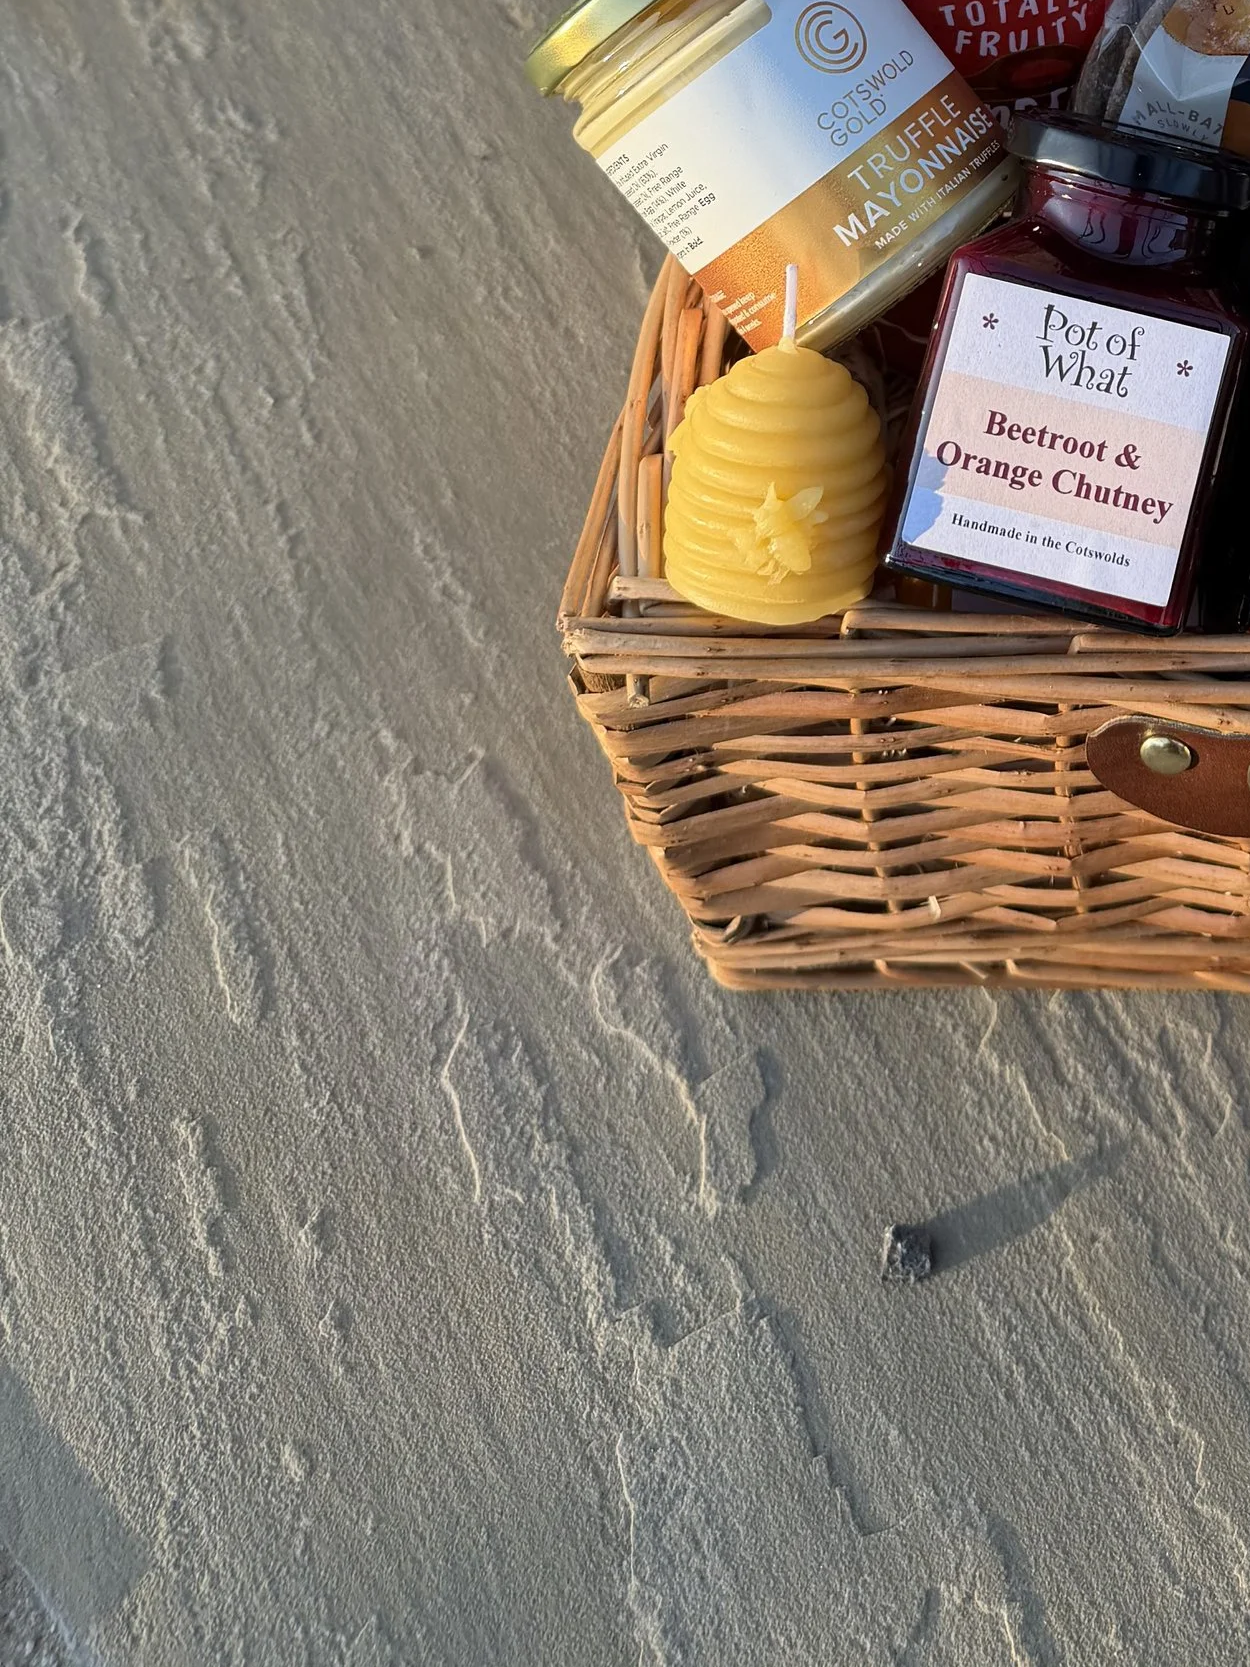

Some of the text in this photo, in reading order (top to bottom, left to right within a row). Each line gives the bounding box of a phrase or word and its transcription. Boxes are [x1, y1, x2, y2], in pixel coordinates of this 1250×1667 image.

[955, 3, 1087, 56] FRUITY
[817, 50, 914, 131] COTSWOLD
[830, 97, 887, 147] GOLD
[848, 94, 961, 190] TRUFFLE
[646, 143, 669, 161] Virgin
[660, 166, 683, 186] Range
[833, 106, 993, 247] MAYONNAISE
[698, 192, 716, 207] Egg
[875, 139, 1000, 250] MADE WITH ITALIAN TRUFFLES
[1036, 304, 1145, 361] Pot of
[1039, 344, 1133, 398] What
[983, 410, 1142, 470] Beetroot &
[936, 441, 1174, 524] Orange Chutney
[951, 513, 1131, 568] Handmade in the Cotswolds
